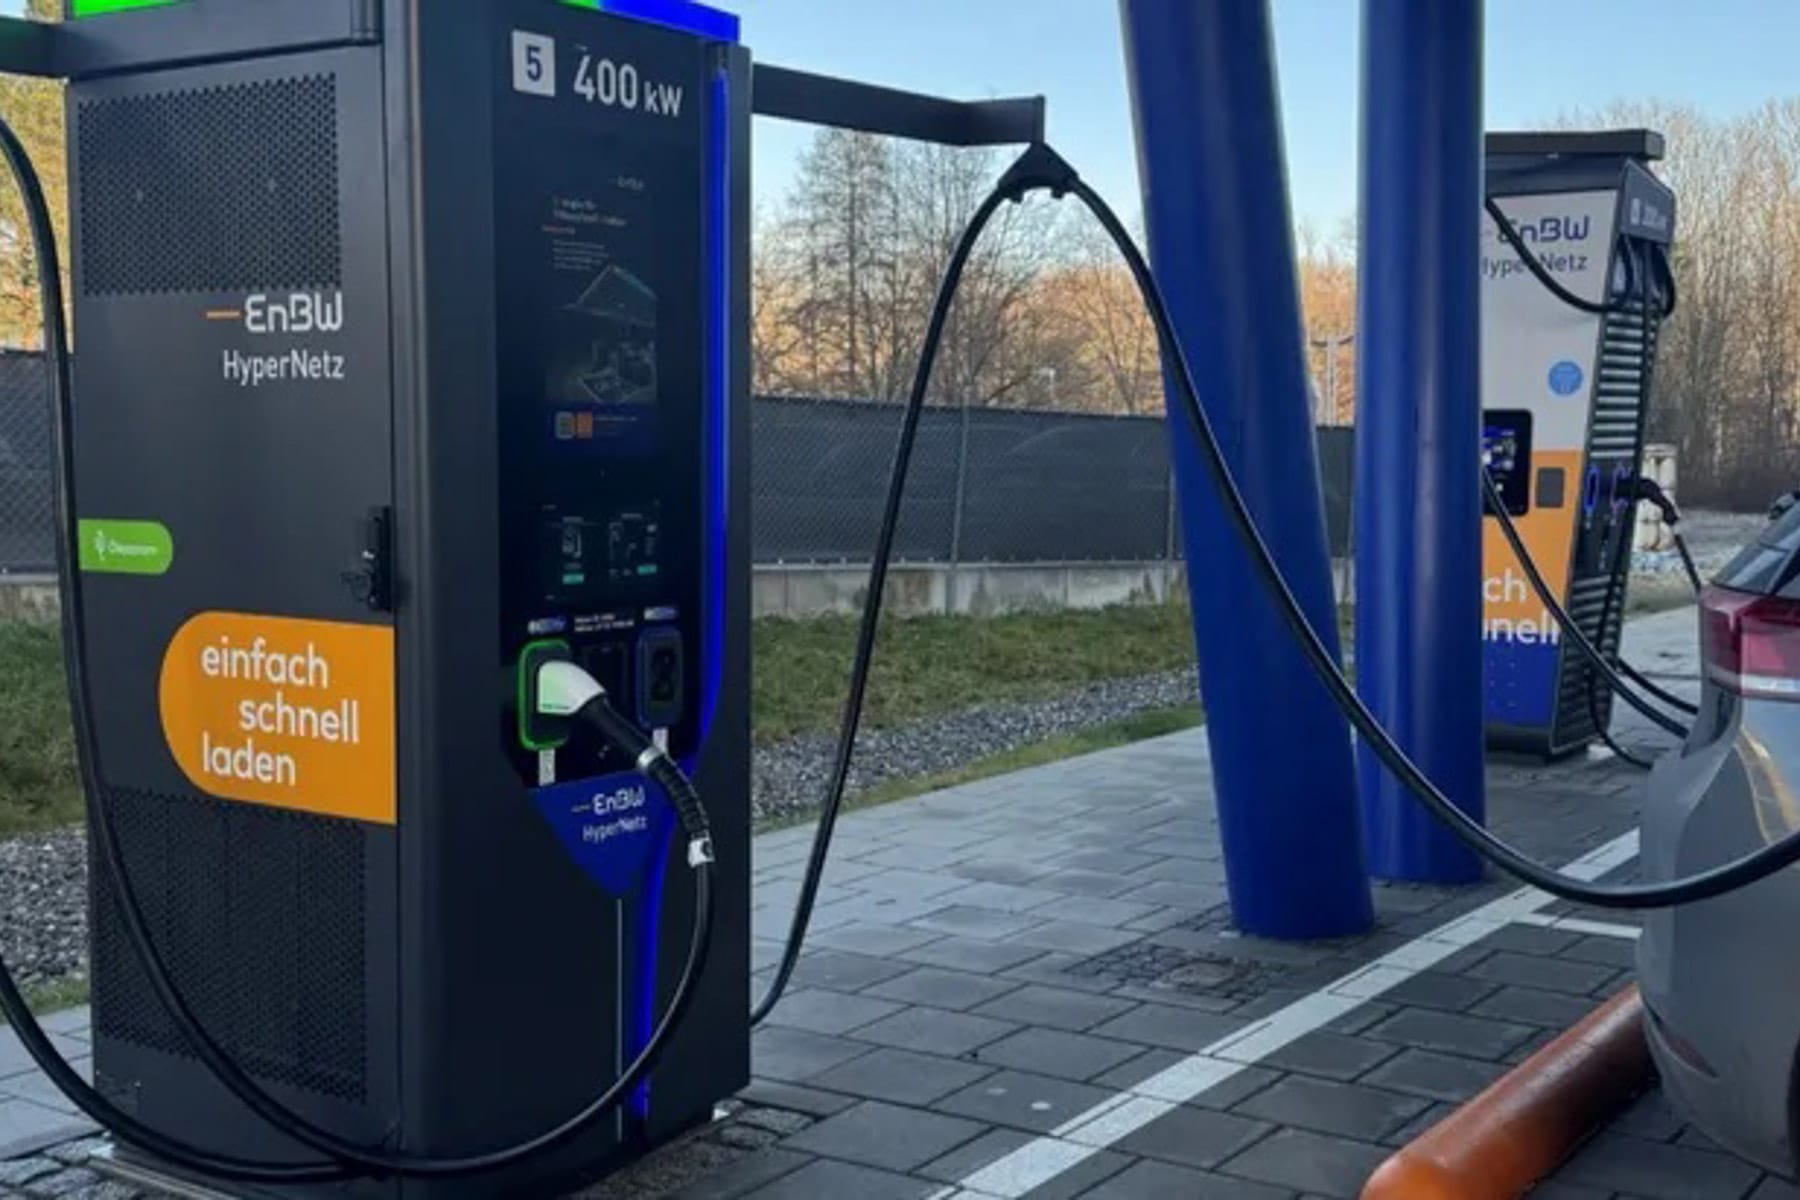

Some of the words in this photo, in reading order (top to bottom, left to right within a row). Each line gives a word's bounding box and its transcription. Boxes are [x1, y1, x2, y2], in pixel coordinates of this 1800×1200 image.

[527, 45, 542, 82] 5
[573, 54, 638, 110] 400
[644, 80, 683, 118] kW
[245, 291, 343, 333] EnBW
[223, 349, 345, 387] HyperNetz
[201, 635, 328, 689] einfach
[239, 690, 360, 744] schnell
[202, 730, 296, 787] laden
[593, 785, 646, 816] EnBW
